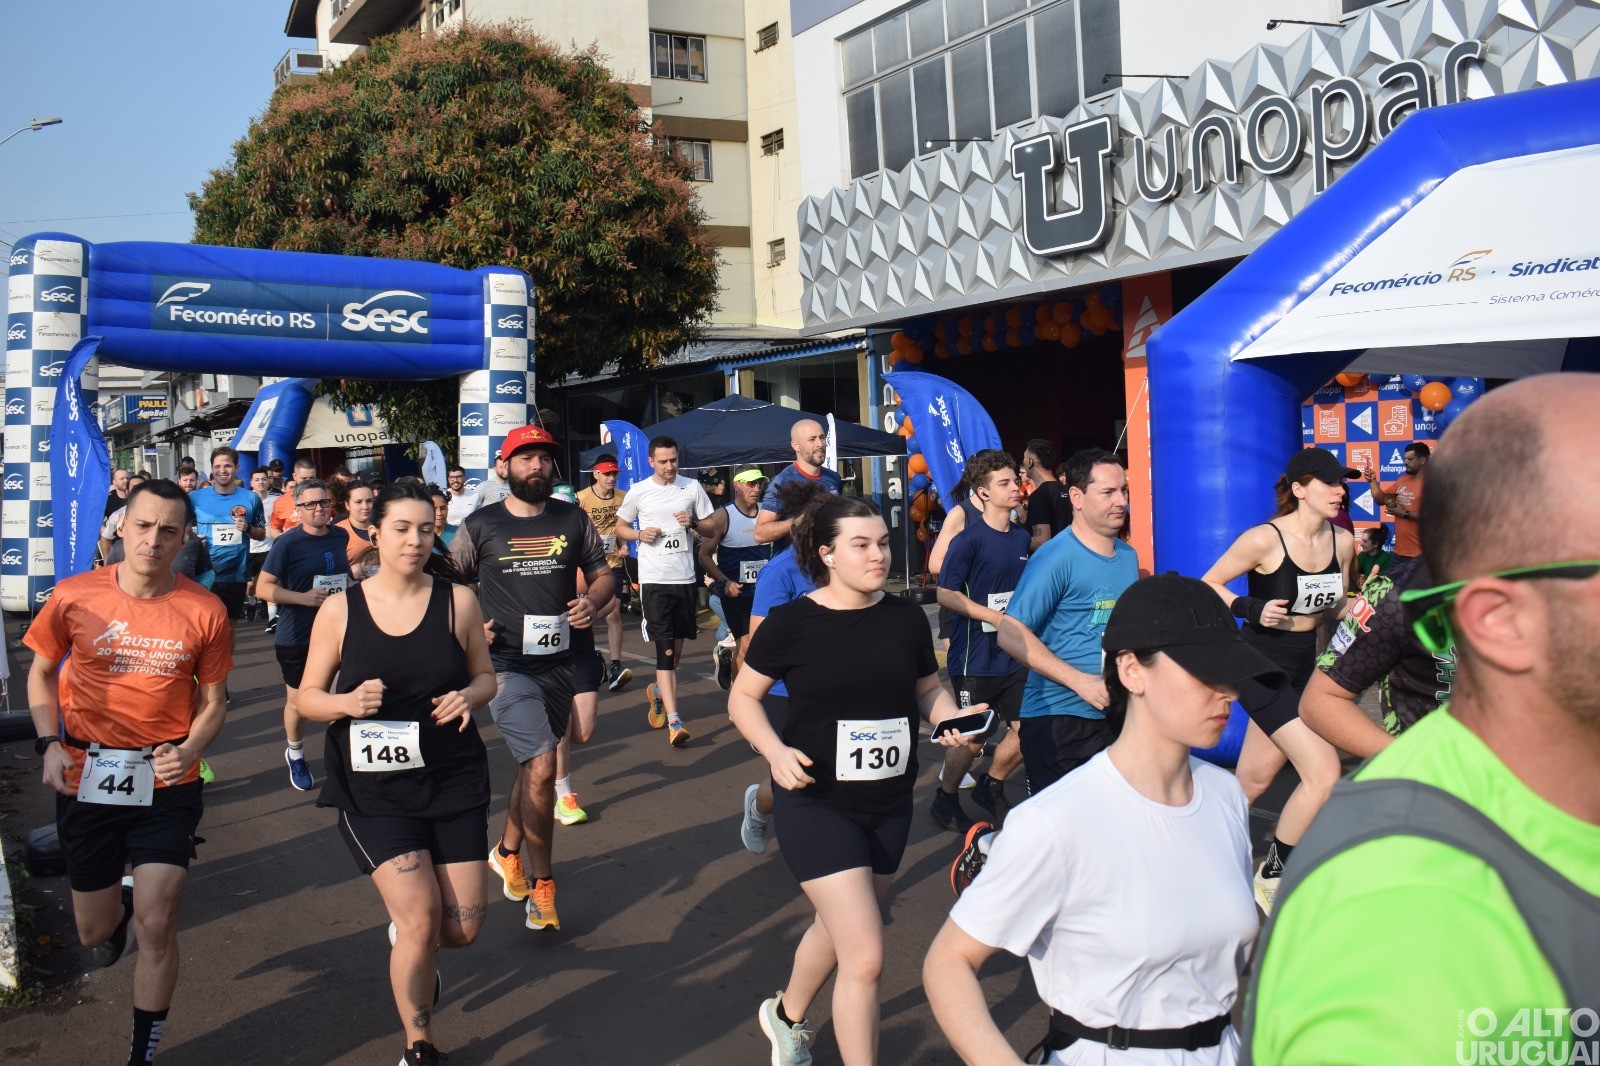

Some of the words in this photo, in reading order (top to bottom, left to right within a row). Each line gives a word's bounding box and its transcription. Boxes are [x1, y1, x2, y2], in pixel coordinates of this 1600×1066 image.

[1133, 39, 1483, 203] unopar
[1328, 271, 1443, 297] Fecomércio
[1446, 266, 1477, 283] RS
[40, 290, 75, 303] Sesc
[1489, 292, 1546, 305] Sistema
[170, 304, 284, 328] Fecomércio
[289, 313, 316, 330] RS
[341, 302, 428, 334] Sesc
[497, 318, 524, 329] Sesc
[495, 384, 522, 395] Sesc
[461, 417, 484, 427] Sesc
[68, 442, 79, 478] Sesc
[220, 533, 234, 542] 27
[664, 538, 680, 550] 40
[522, 559, 557, 567] CORRIDA
[1304, 582, 1322, 590] Sesc
[1304, 592, 1336, 608] 165
[532, 622, 552, 630] Sesc
[120, 634, 184, 651] RÚSTICA
[537, 632, 561, 648] 46
[97, 647, 113, 657] 20
[115, 648, 147, 658] ANOS
[148, 652, 192, 662] UNOPAR
[114, 656, 177, 669] FREDERICO
[360, 729, 385, 739] Sesc
[850, 731, 878, 741] Sesc
[361, 744, 411, 764] 148
[849, 745, 900, 770] 130
[95, 758, 120, 769] Sesc
[97, 773, 135, 796] 44
